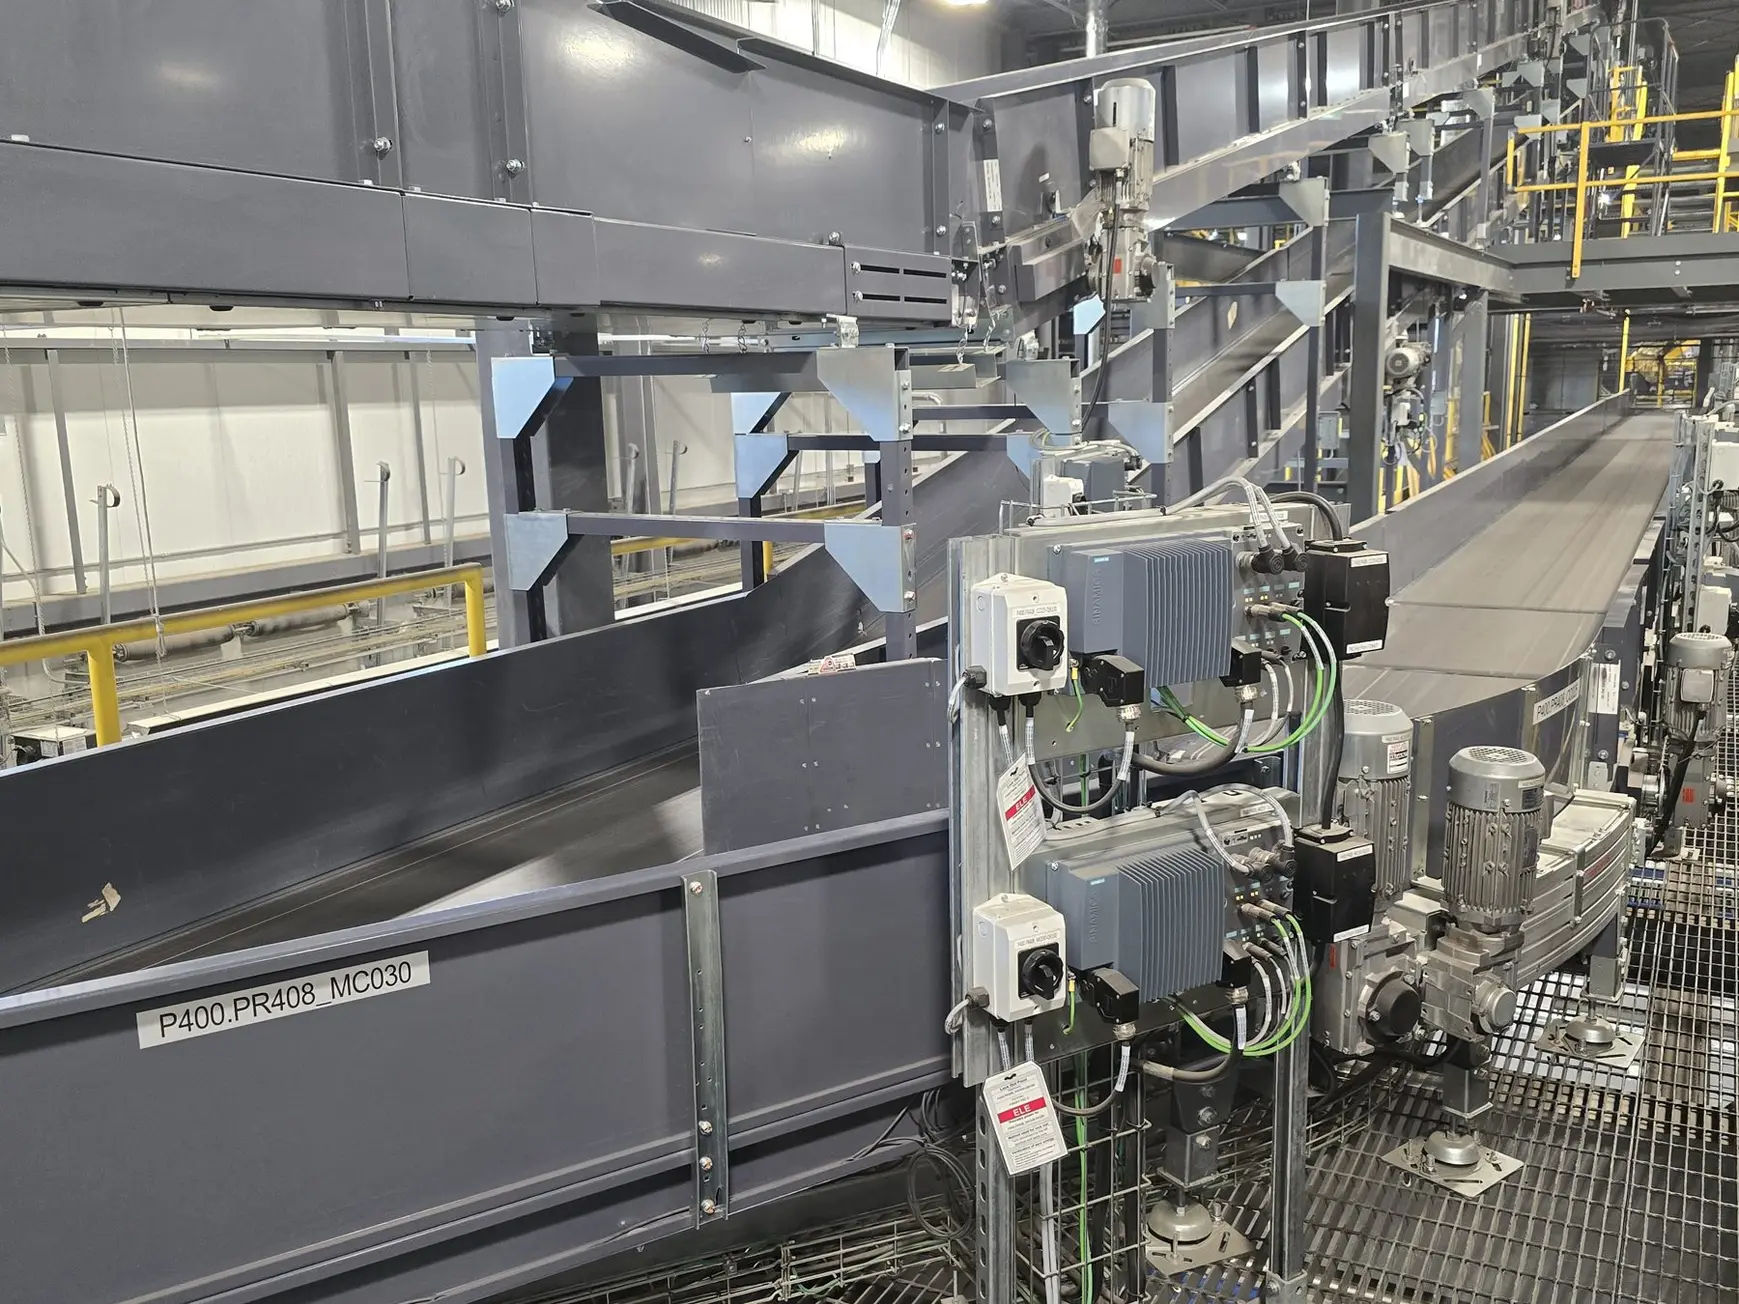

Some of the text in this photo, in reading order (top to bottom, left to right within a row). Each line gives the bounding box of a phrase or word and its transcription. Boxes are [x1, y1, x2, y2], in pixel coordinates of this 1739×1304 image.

[1015, 796, 1028, 811] ELE
[158, 961, 412, 1038] P400.PR408_MC030
[1013, 1106, 1032, 1116] ELE
